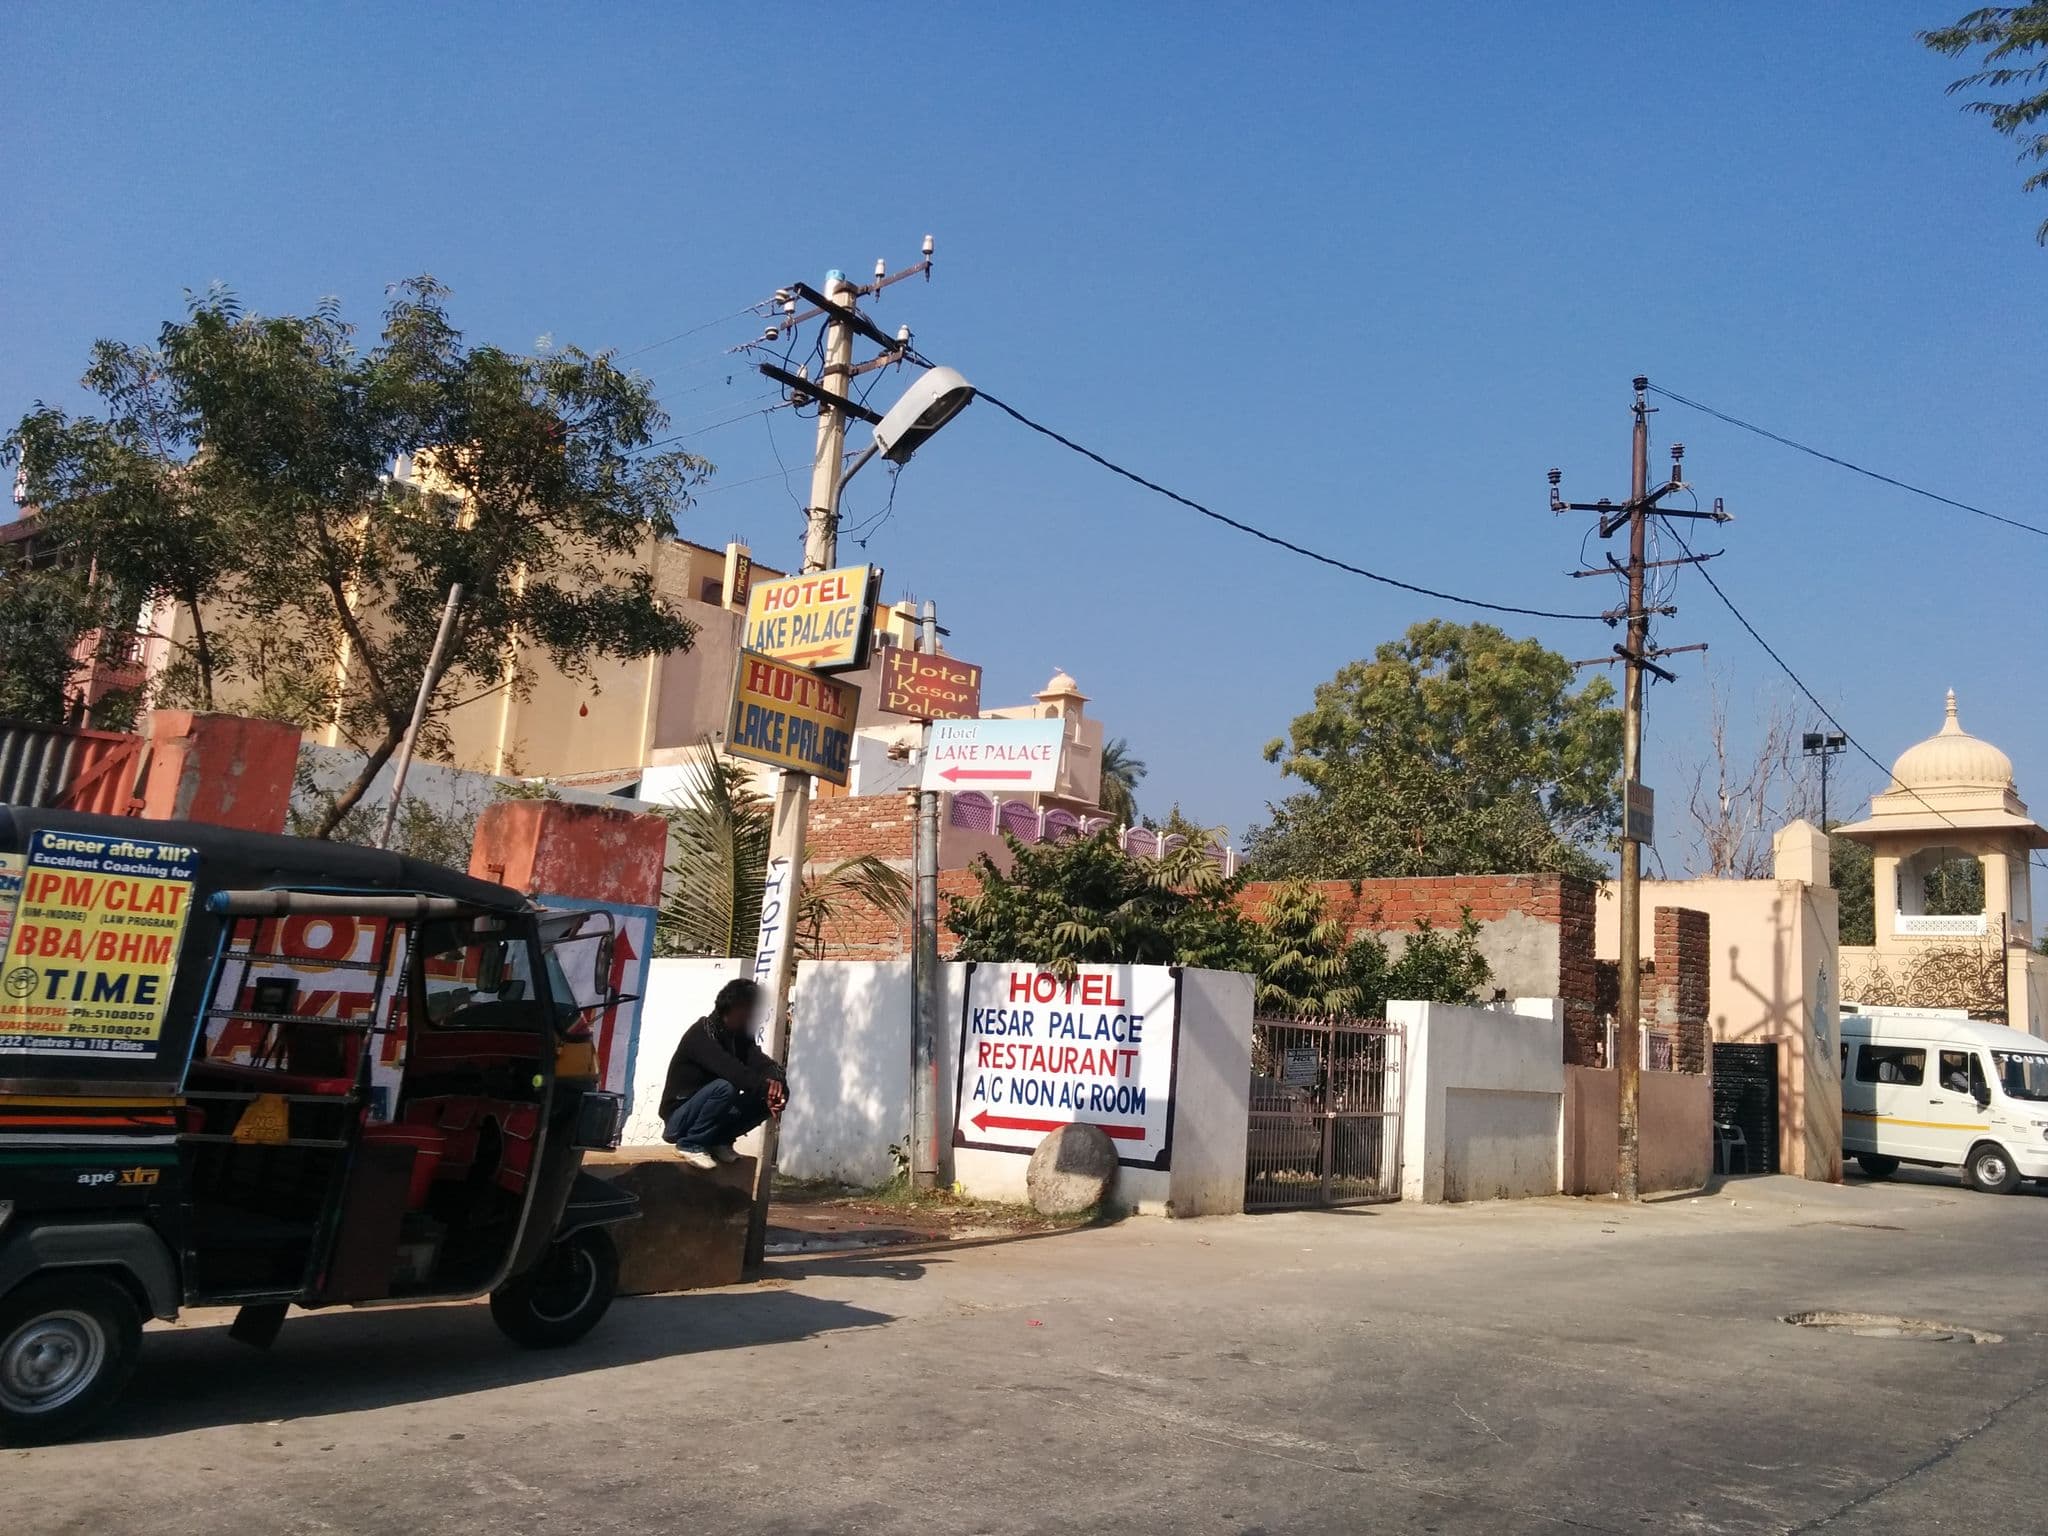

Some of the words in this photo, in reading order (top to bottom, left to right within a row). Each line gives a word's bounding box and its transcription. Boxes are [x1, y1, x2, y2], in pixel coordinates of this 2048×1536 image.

[737, 558, 748, 594] HOTEL
[763, 577, 850, 611] HOTEL
[746, 616, 787, 652] LAKE
[791, 606, 857, 647] PALACE
[889, 653, 976, 687] Hotel
[746, 660, 847, 719] HOTEL
[897, 674, 968, 703] Kesar
[733, 700, 785, 753] LAKE
[786, 715, 849, 772] PALACE
[937, 726, 978, 740] Hotel
[935, 745, 980, 761] LAKE
[984, 745, 1052, 761] PALACE
[33, 853, 98, 870] Excellent
[103, 861, 168, 878] Coaching
[171, 866, 192, 878] for
[42, 834, 105, 854] Career
[109, 843, 154, 858] after
[157, 846, 190, 862] XII?
[25, 873, 186, 915] IPM/CLAT
[15, 925, 173, 965] BBA/BHM
[45, 968, 161, 1005] T.I.M.E.
[1009, 972, 1125, 1007] HOTEL
[972, 1007, 1034, 1037] KESAR
[1049, 1011, 1144, 1043] PALACE
[24, 1037, 71, 1049] Centres
[73, 1037, 86, 1048] in
[90, 1040, 109, 1050] 116
[111, 1042, 144, 1051] Cities
[977, 1041, 1139, 1078] RESTAURANT
[972, 1073, 1003, 1103] A/C
[1009, 1077, 1055, 1107] NON
[1058, 1080, 1085, 1111] A/C
[1090, 1083, 1146, 1115] ROOM
